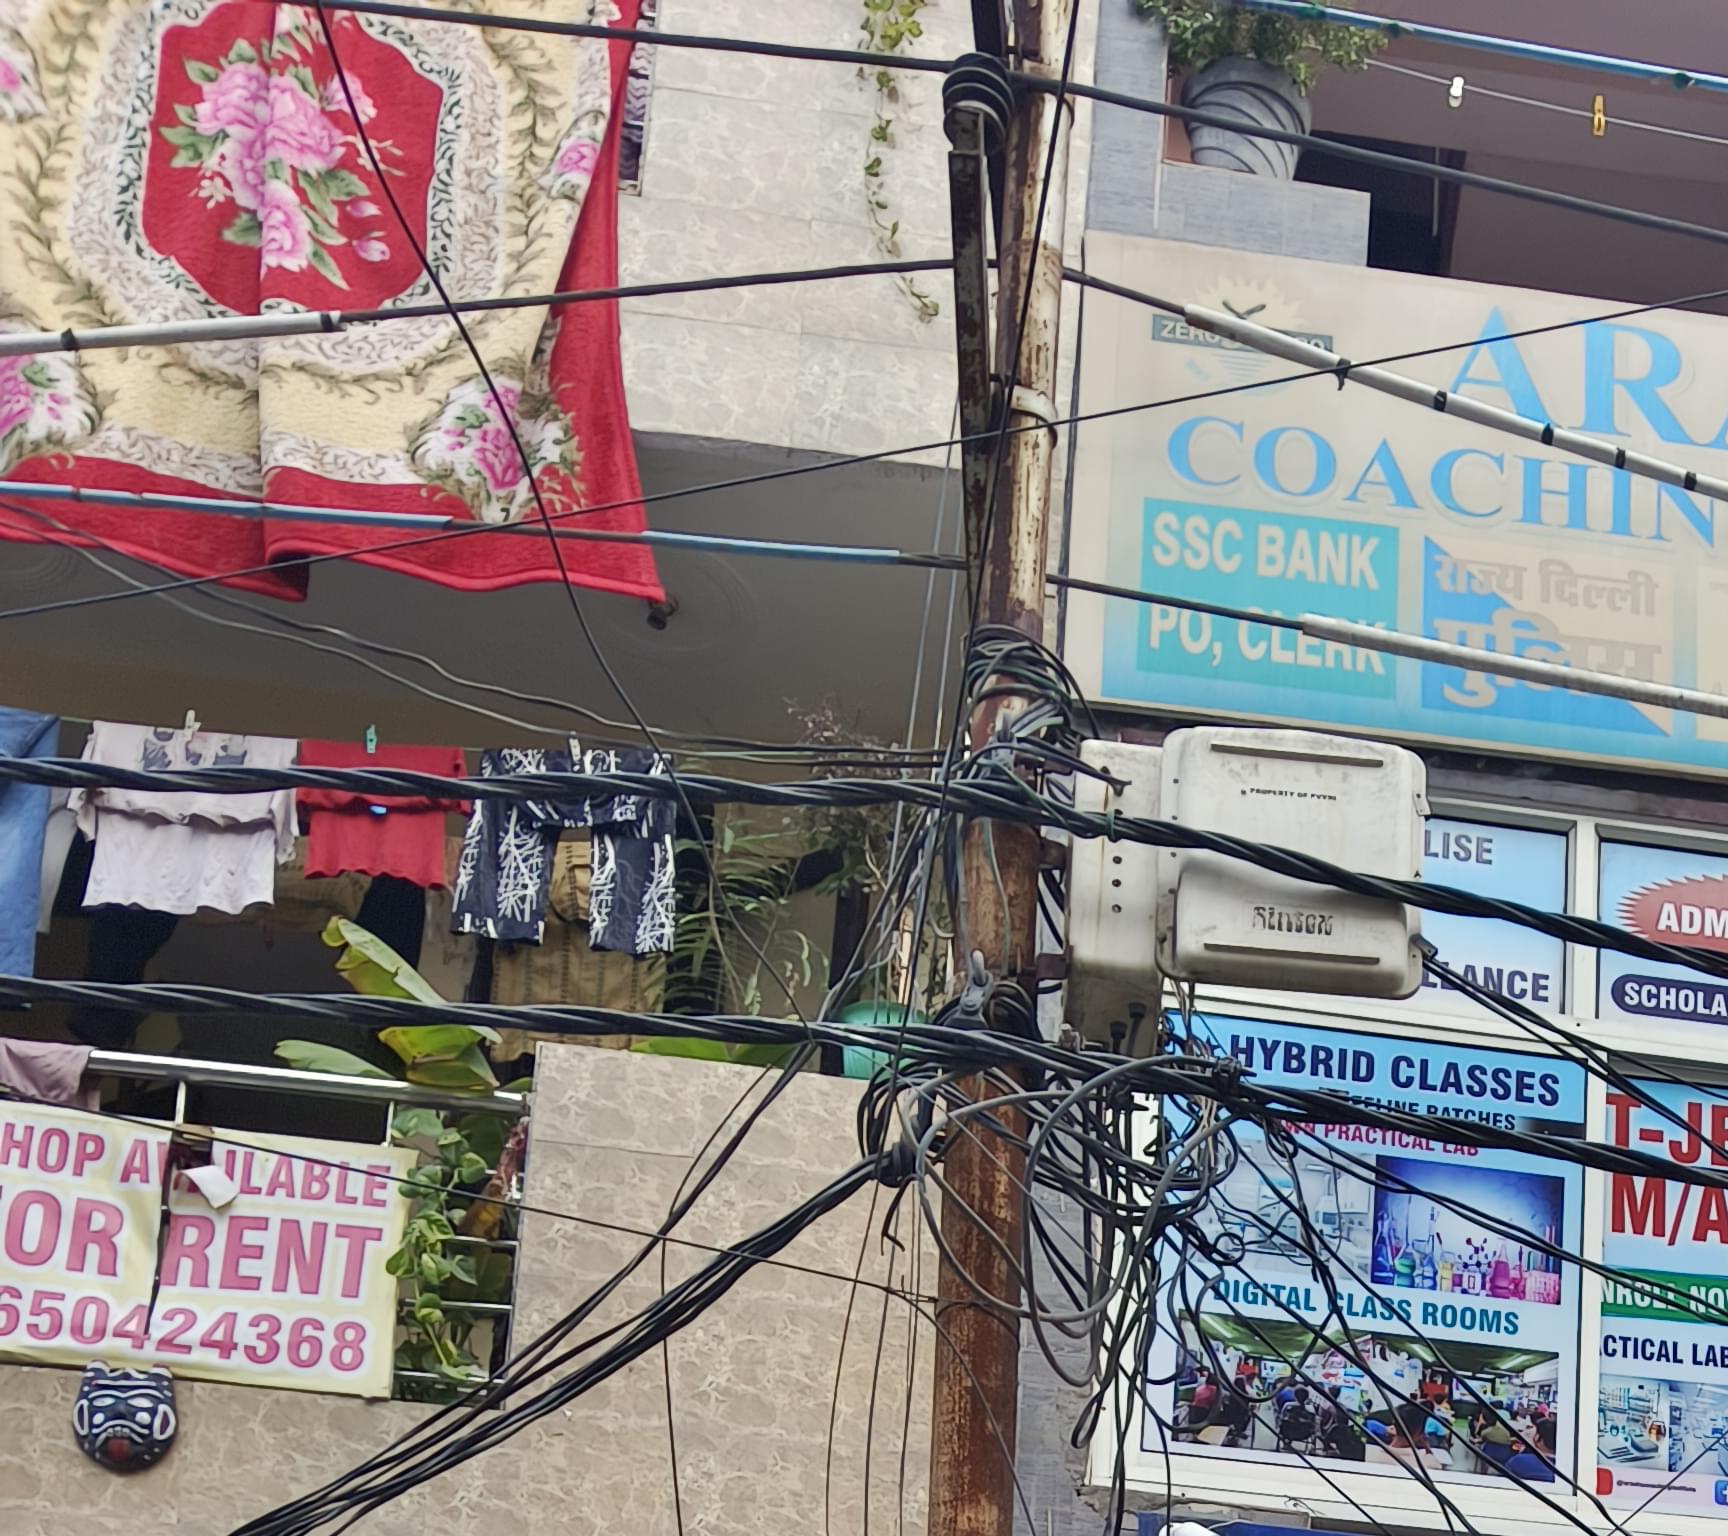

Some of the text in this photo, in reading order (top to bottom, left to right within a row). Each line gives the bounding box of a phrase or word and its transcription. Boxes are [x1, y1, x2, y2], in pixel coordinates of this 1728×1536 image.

[1152, 512, 1379, 590] SSC BANK
[1433, 550, 1659, 617] राज्य दिल्ली
[1149, 604, 1387, 675] PO, CLERK
[1230, 1034, 1561, 1108] HYBRID CLASSES
[1323, 1124, 1435, 1154] PRACTICAL
[161, 1214, 383, 1300] RENT
[1213, 1277, 1520, 1336] DIGITAL CLASS ROOMS
